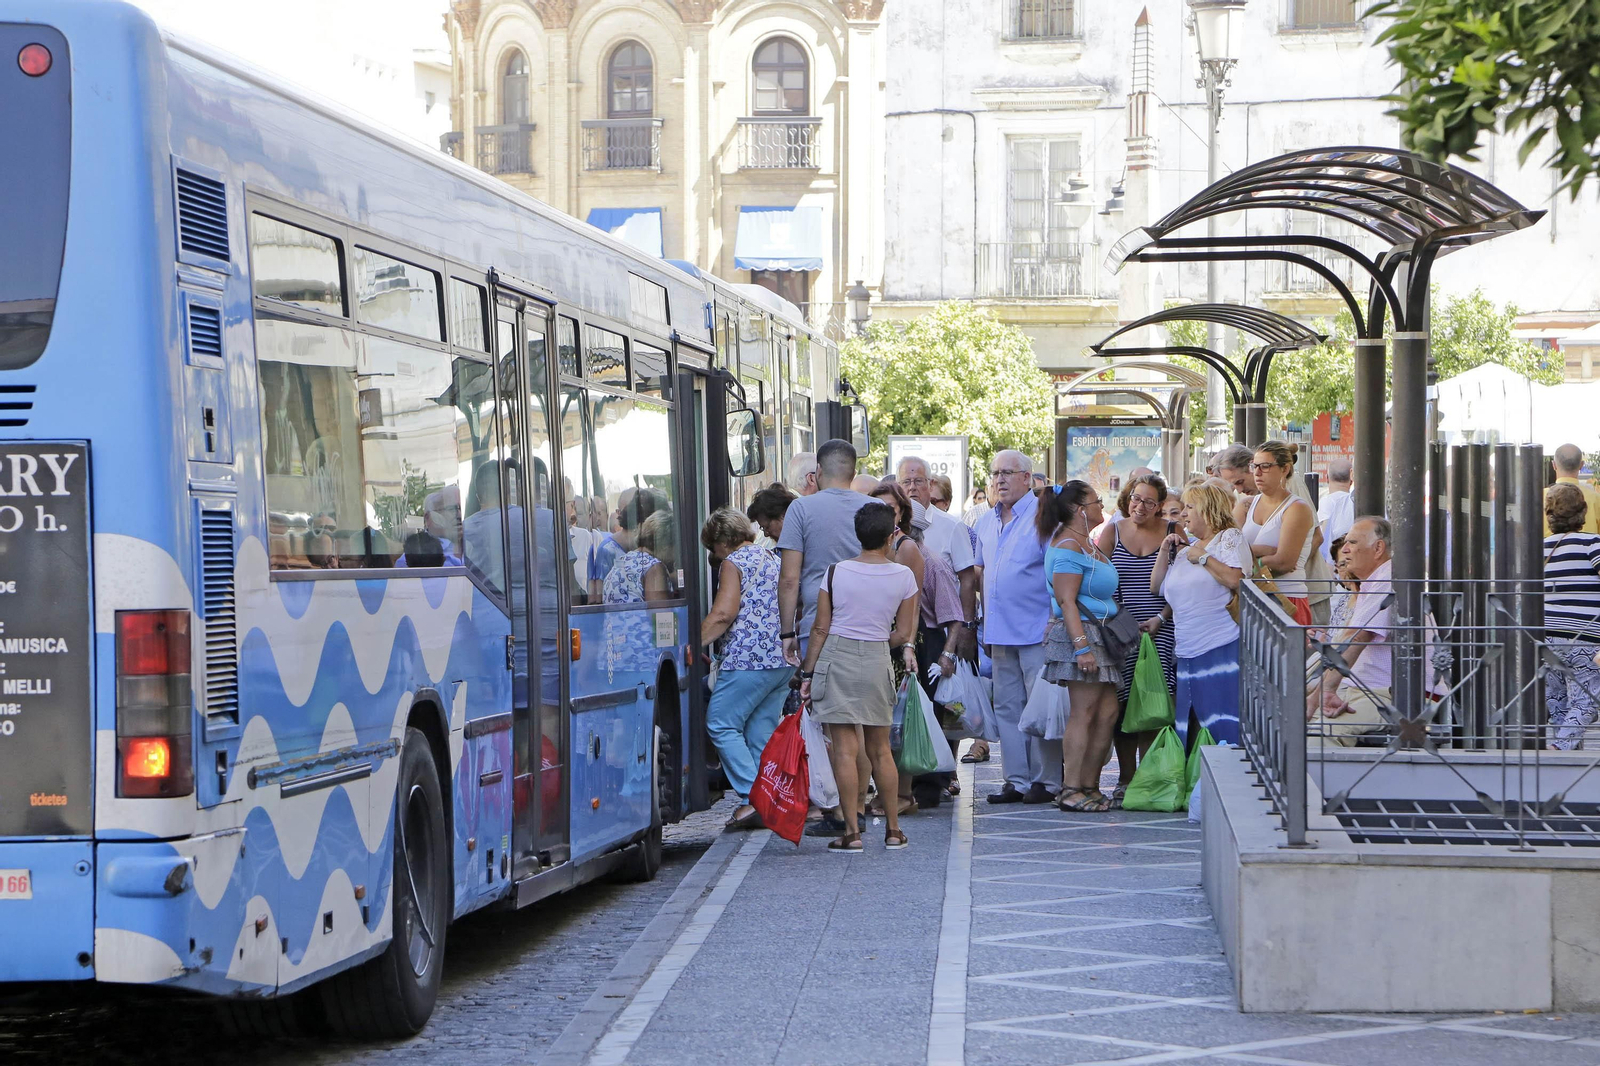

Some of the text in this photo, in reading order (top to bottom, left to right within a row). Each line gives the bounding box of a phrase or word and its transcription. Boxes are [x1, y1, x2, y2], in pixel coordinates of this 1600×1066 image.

[1072, 434, 1161, 447] ESPÍRITU MEDITERRÁN
[0, 453, 79, 496] RY
[35, 505, 67, 532] h.
[3, 678, 51, 694] MELLI
[30, 792, 68, 806] ticketea
[8, 876, 28, 893] 66
